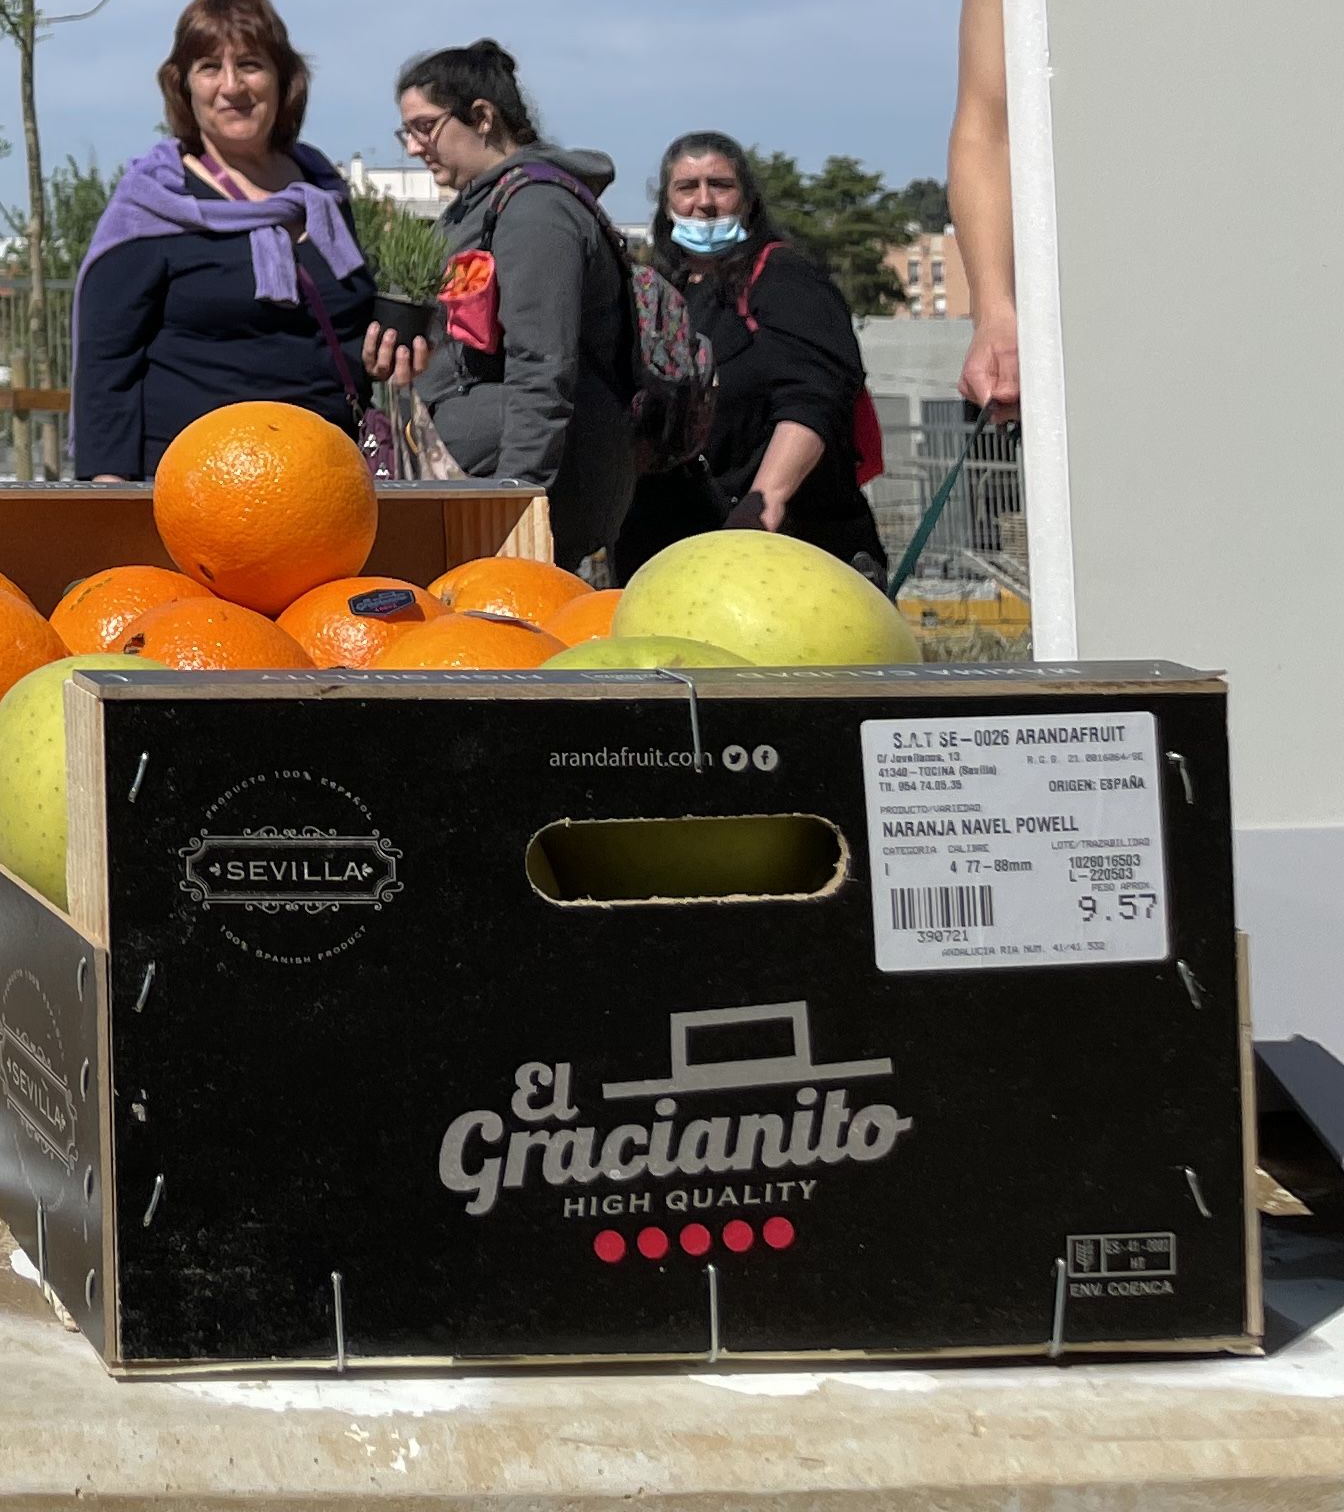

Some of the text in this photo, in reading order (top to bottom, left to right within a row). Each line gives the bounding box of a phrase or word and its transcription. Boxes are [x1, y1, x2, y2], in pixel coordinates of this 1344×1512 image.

[261, 673, 543, 681] HIGH QUALITY
[736, 669, 919, 679] CALIDAD
[939, 728, 1010, 748] SE-0026
[1015, 725, 1126, 745] ARANDAFRUIT
[549, 746, 714, 768] arandafruit.com
[1048, 774, 1146, 793] ORIGEN: ESPAÑA
[205, 769, 373, 821] PRODUCTO 100% ESPAÑOL
[879, 803, 982, 815] PRODUCTO/VARIEDAD
[883, 815, 1080, 837] NARANJA NAVEL POWELL
[882, 846, 937, 856] CATEGORIA
[947, 843, 990, 854] CALIBRE
[1050, 837, 1151, 850] LOTE/TRAZABILIDAD
[225, 860, 365, 882] SEVILLA
[950, 861, 957, 874] 4
[1068, 867, 1134, 882] L-220503
[1078, 893, 1158, 922] 9.57
[219, 924, 367, 965] 100% SPANISH PRODUCT
[916, 929, 969, 944] 390721
[11, 1062, 62, 1128] SEVILLA
[510, 1060, 582, 1122] El
[437, 1086, 914, 1217] Gracianito
[562, 1179, 819, 1219] HIGH QUALITY
